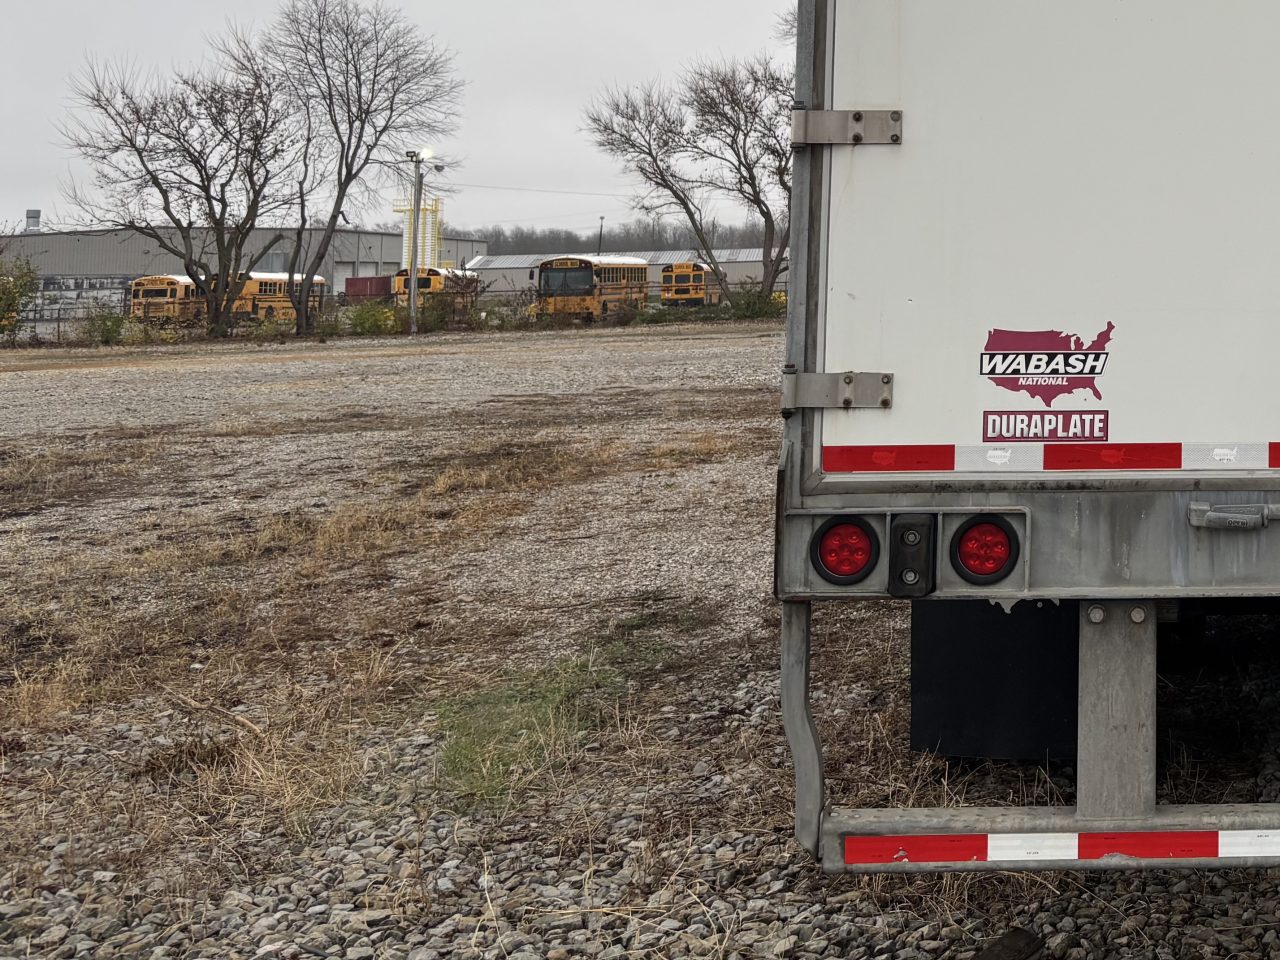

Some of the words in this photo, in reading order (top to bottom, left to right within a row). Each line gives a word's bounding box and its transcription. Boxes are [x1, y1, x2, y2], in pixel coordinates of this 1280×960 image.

[982, 354, 1106, 374] WABASH
[1018, 377, 1069, 385] NATIONAL
[987, 414, 1105, 438] DURAPLATE
